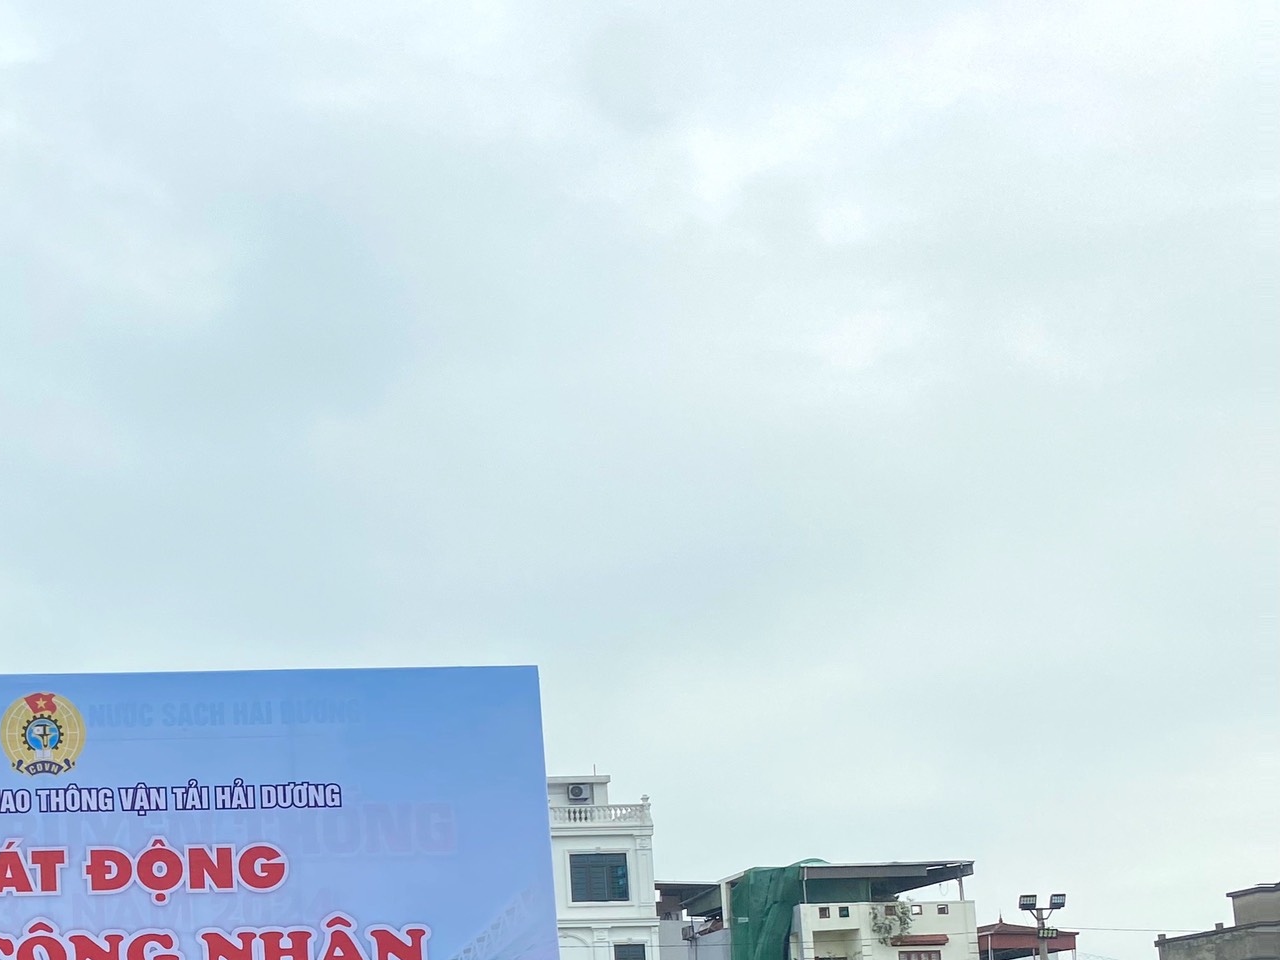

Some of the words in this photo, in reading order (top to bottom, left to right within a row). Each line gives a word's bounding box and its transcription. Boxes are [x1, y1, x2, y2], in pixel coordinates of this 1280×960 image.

[35, 783, 114, 814] THÔNG
[118, 782, 167, 816] VẬN
[172, 778, 210, 811] TẢI
[214, 777, 255, 810] HẢI
[260, 781, 343, 809] DƯƠNG
[85, 838, 286, 902] ĐỘNG
